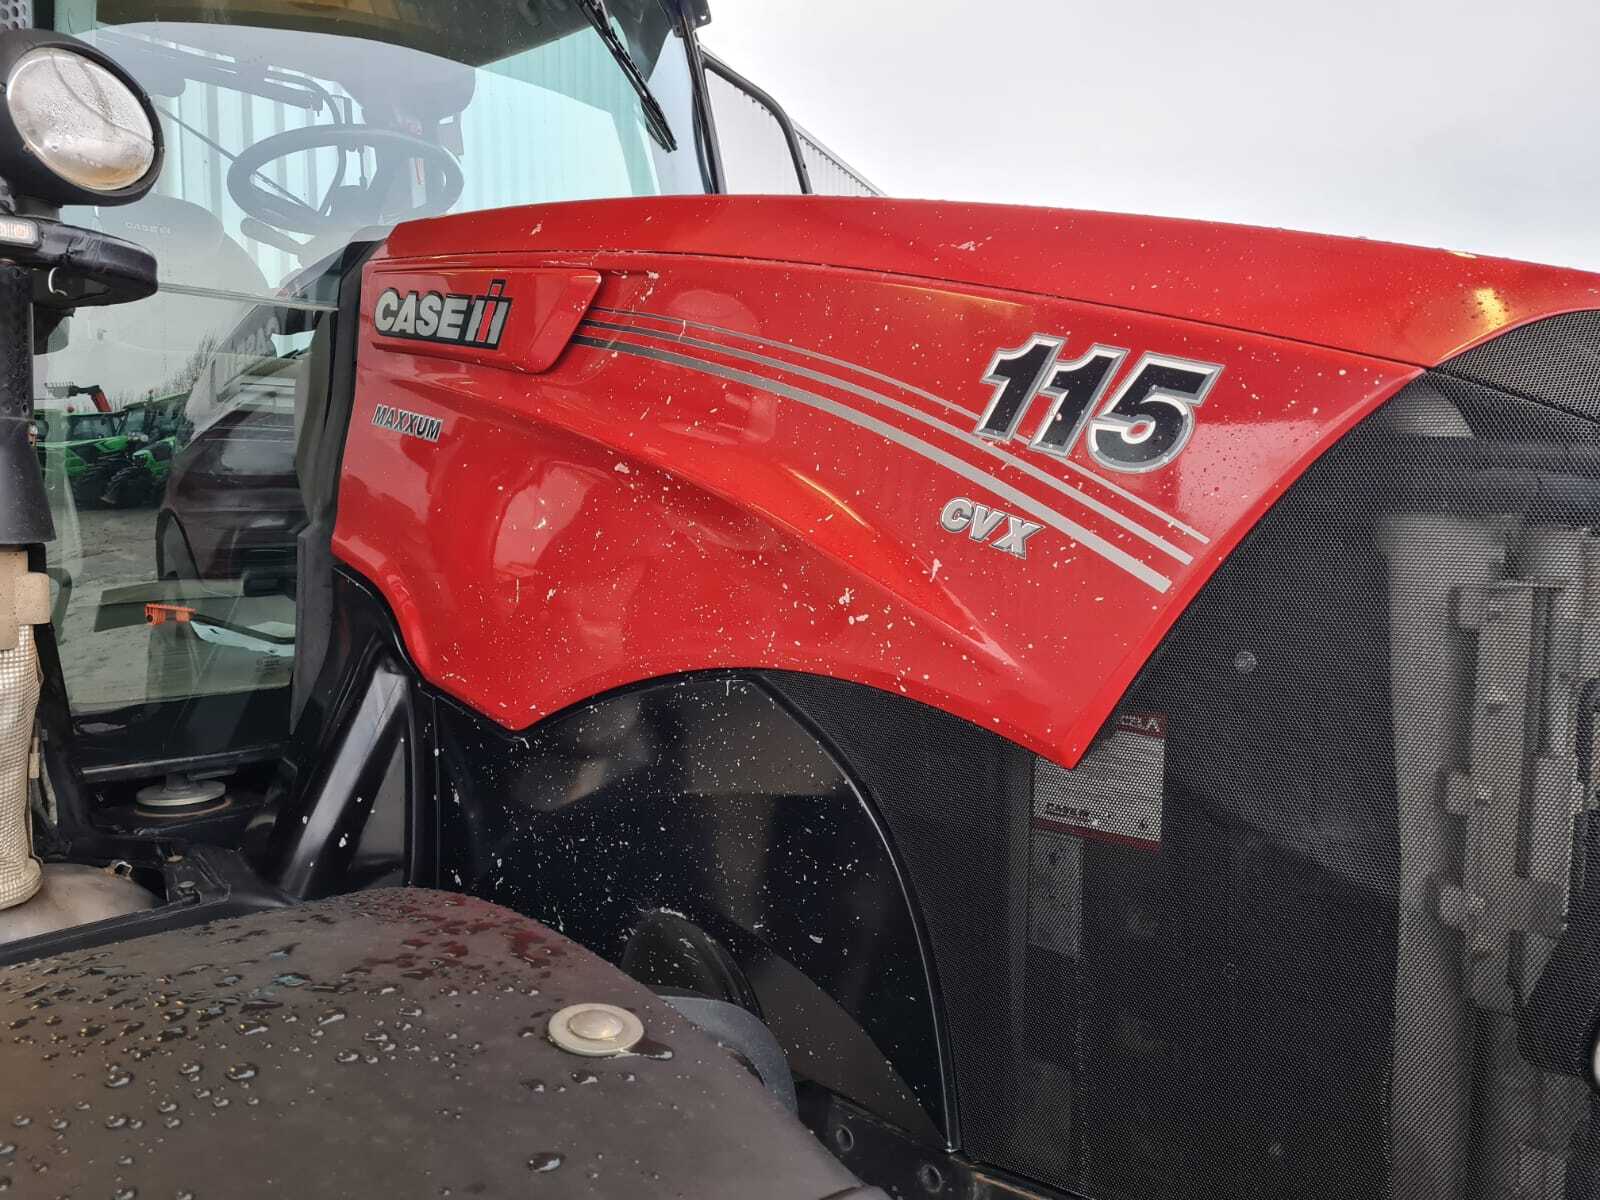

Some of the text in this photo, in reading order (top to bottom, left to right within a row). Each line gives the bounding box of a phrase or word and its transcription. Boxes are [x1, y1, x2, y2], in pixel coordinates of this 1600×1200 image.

[372, 403, 443, 442] MAXXUM
[974, 332, 1225, 475] 115
[940, 496, 1045, 559] CVX
